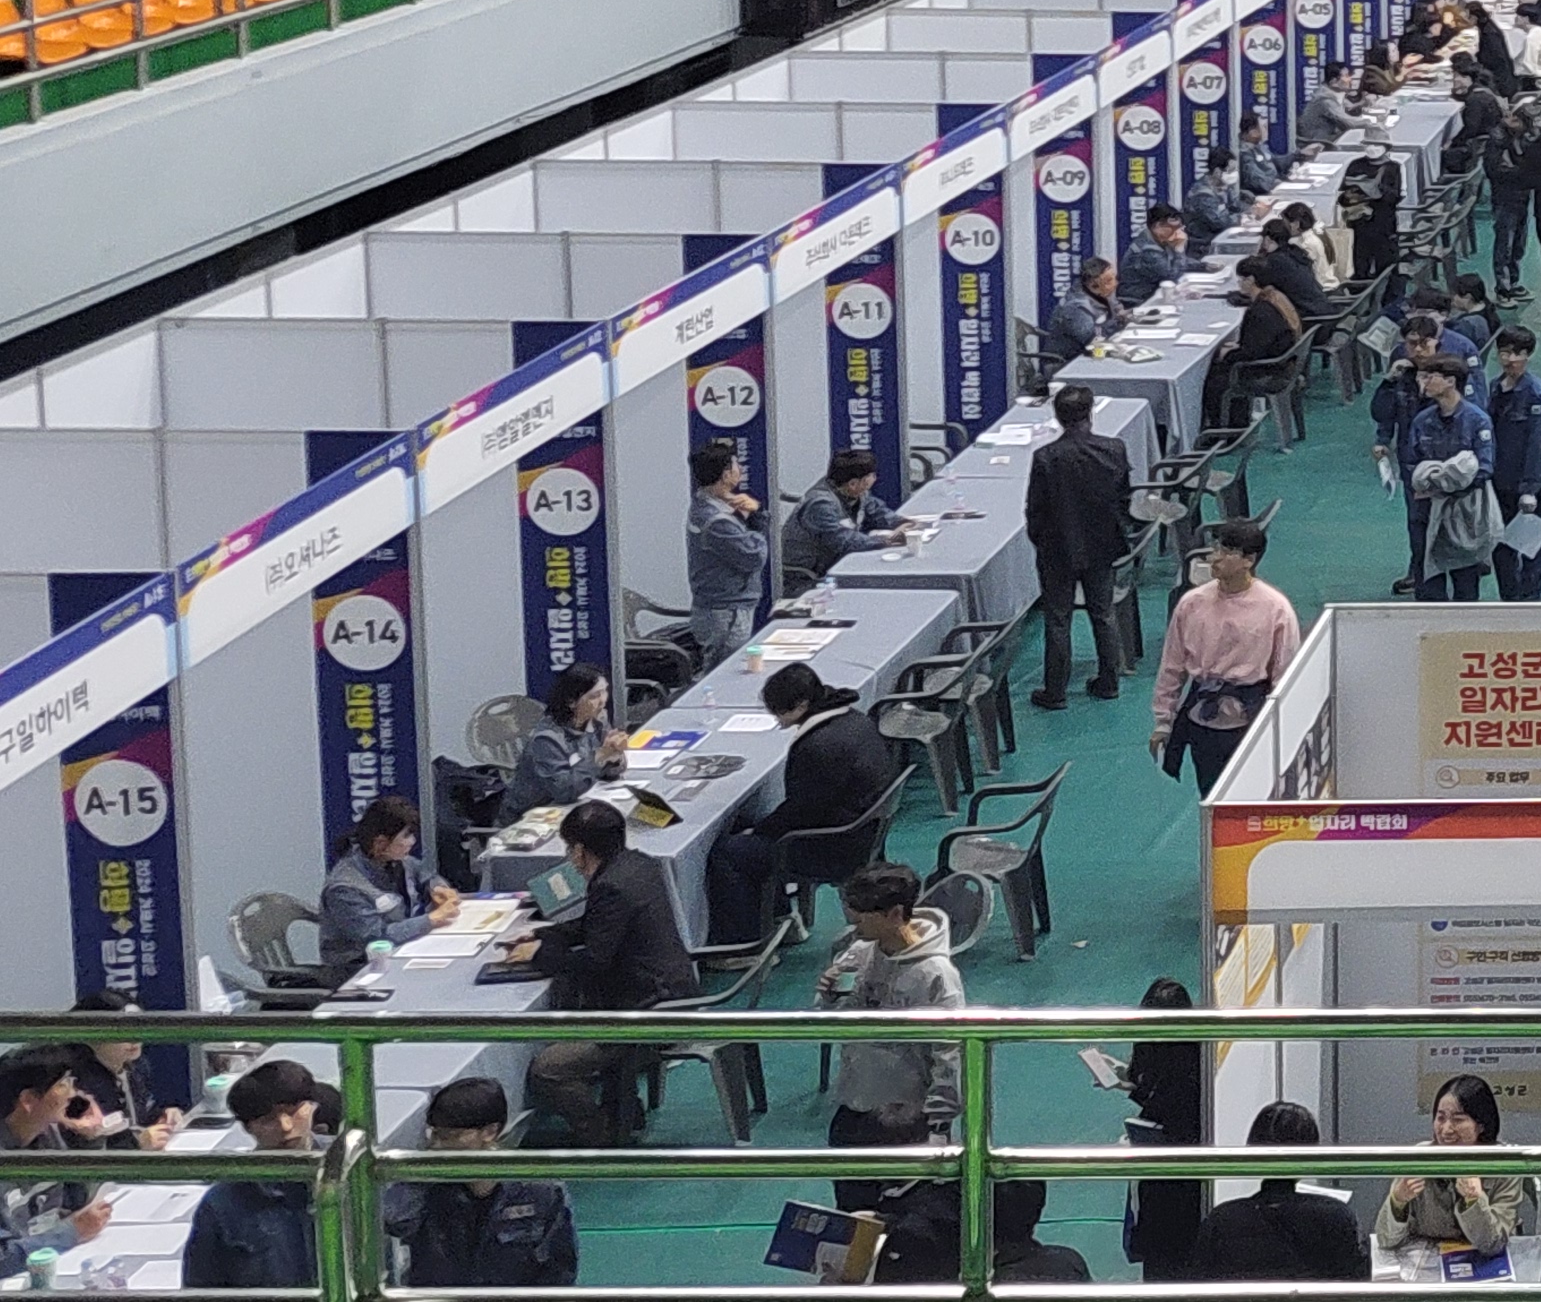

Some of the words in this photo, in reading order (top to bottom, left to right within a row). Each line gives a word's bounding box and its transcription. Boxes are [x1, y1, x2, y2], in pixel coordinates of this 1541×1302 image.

[1298, 3, 1331, 17] A-05
[1246, 38, 1282, 53] A-06
[1185, 75, 1224, 90] A-07
[1120, 119, 1163, 135] A-08
[1042, 170, 1086, 187] A-09
[950, 229, 996, 247] A-10
[837, 302, 884, 320] A-11
[701, 385, 755, 407] A-12
[533, 490, 594, 513] A-13
[330, 618, 400, 645] A-14
[83, 787, 158, 817] A-15
[1308, 813, 1356, 832] 일자리
[1360, 813, 1408, 831] 박람회
